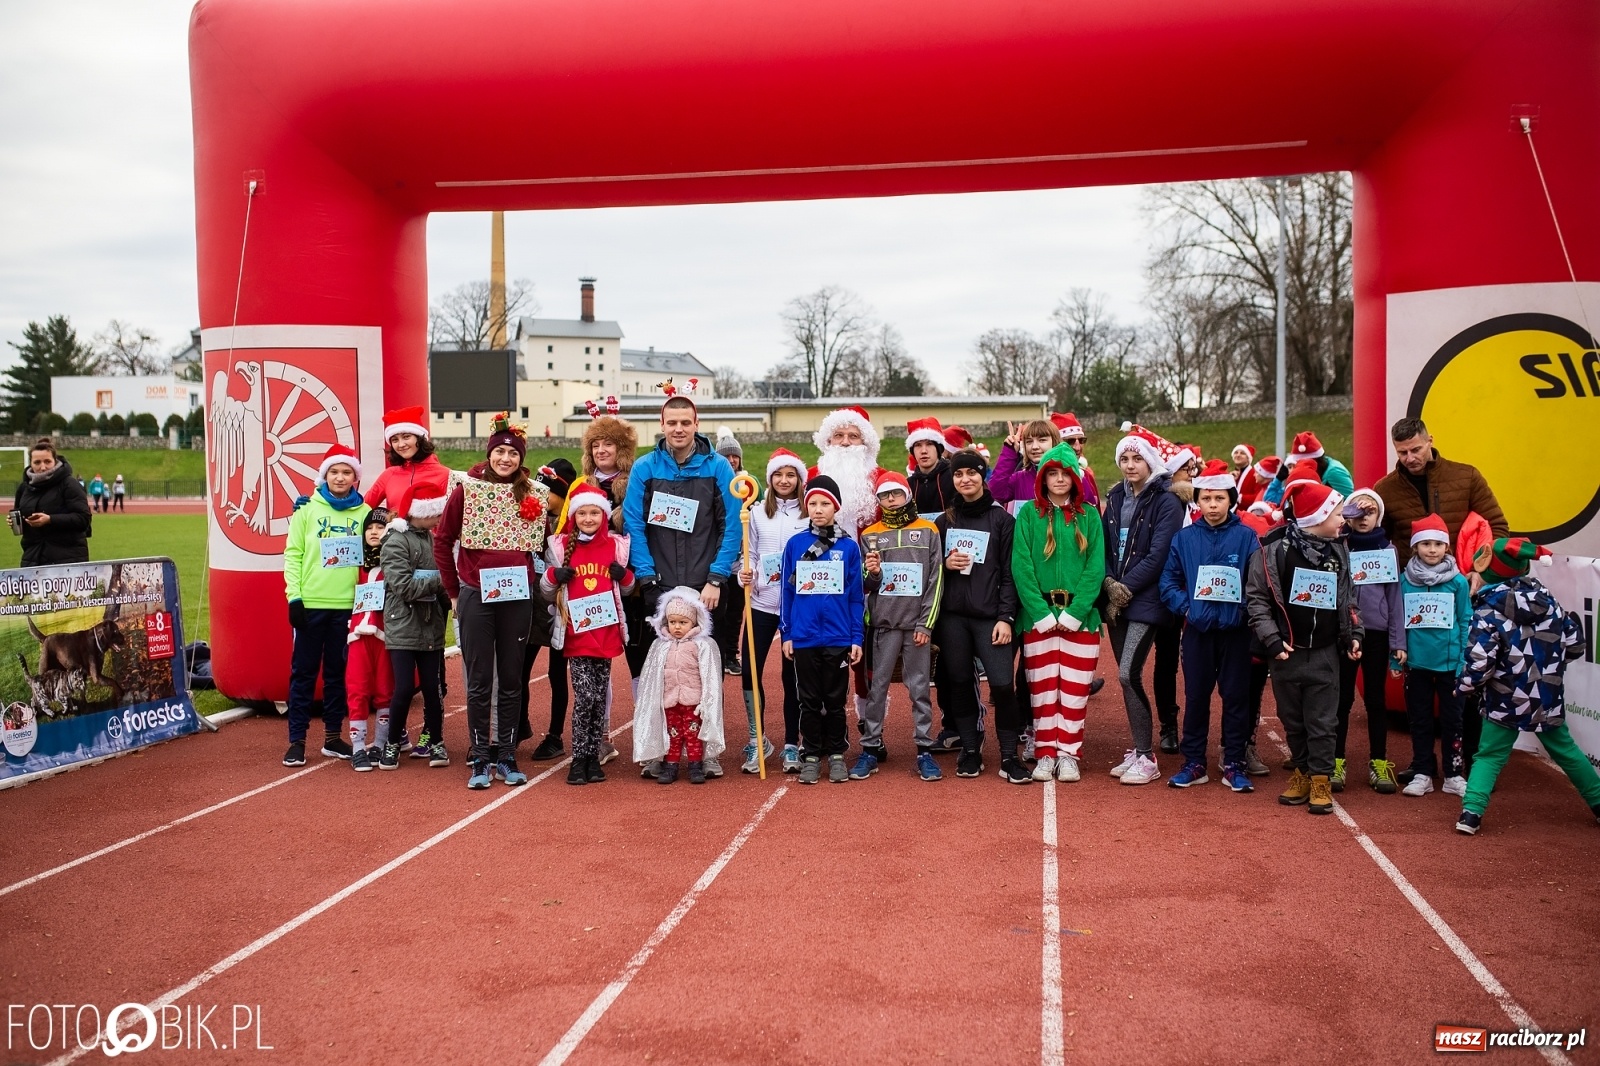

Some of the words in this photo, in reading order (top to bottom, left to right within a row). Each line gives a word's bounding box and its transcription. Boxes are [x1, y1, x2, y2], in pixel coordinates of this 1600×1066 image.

[146, 386, 166, 394] DOM
[667, 506, 680, 516] 175
[957, 540, 973, 548] 009
[336, 547, 350, 555] 147
[1362, 560, 1380, 570] 005
[811, 572, 829, 580] 032
[893, 574, 908, 582] 210
[0, 575, 38, 600] olejne
[42, 578, 72, 598] pory
[74, 571, 97, 591] roku
[497, 578, 513, 588] 135
[1211, 577, 1227, 587] 186
[1309, 583, 1327, 593] 025
[0, 603, 29, 615] ochrona
[31, 600, 52, 614] przed
[586, 605, 602, 616] 008
[1419, 604, 1438, 614] 207
[156, 612, 164, 631] 8
[123, 702, 186, 733] foresto
